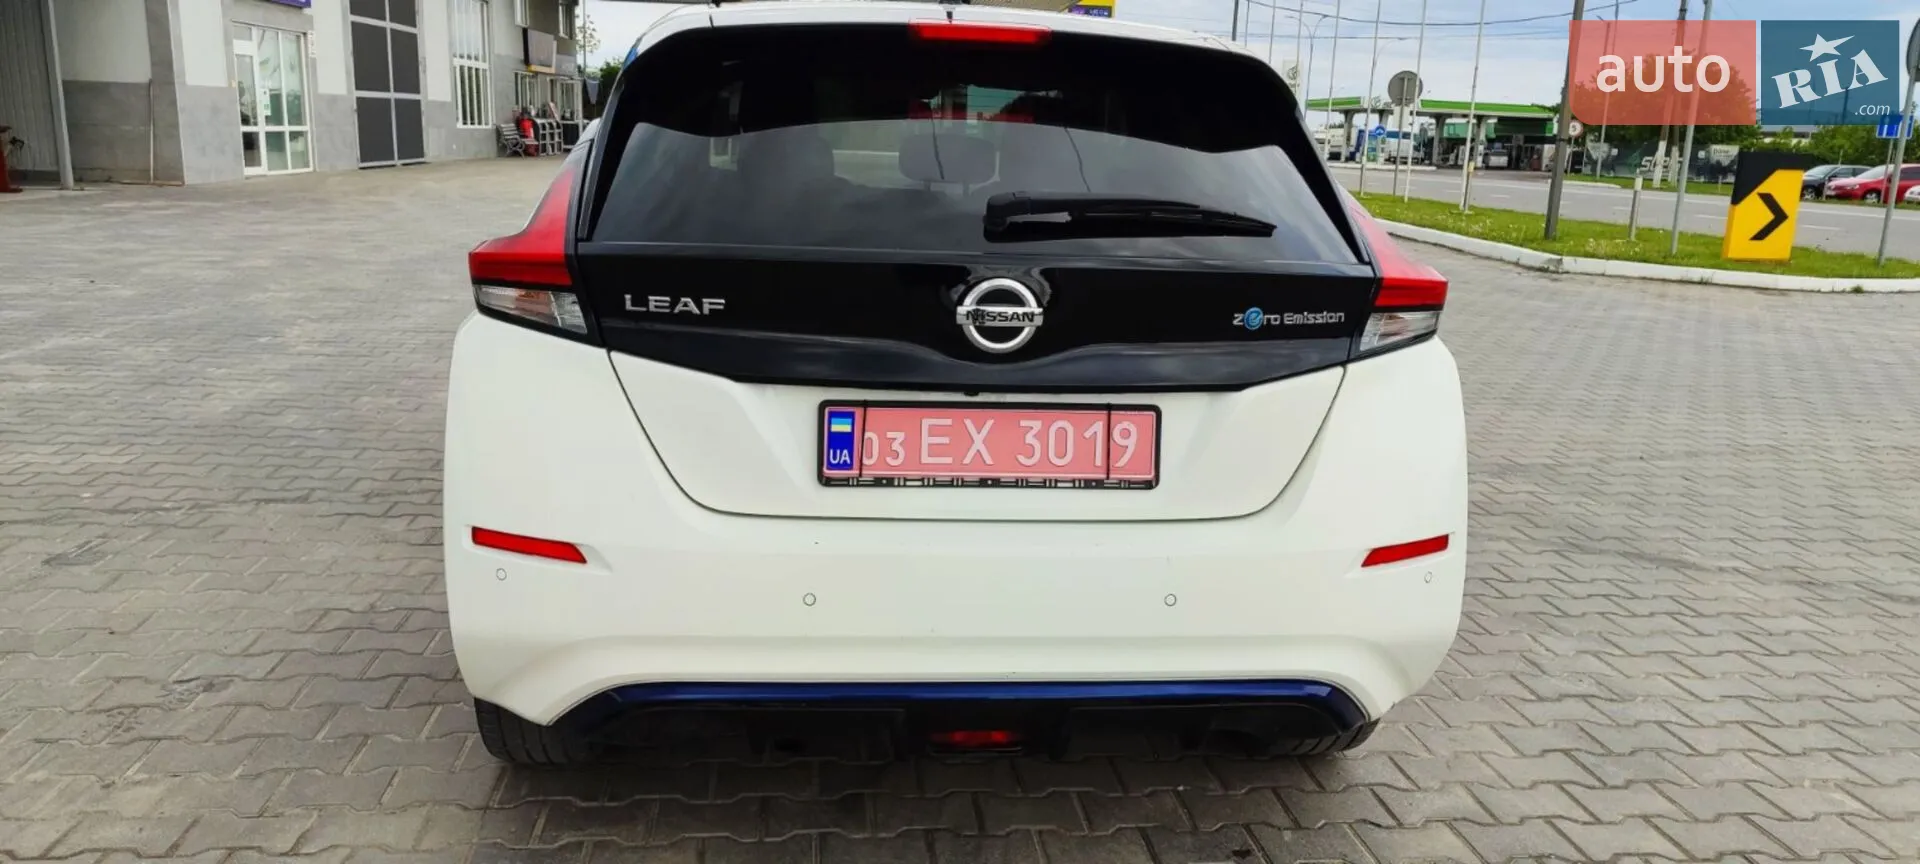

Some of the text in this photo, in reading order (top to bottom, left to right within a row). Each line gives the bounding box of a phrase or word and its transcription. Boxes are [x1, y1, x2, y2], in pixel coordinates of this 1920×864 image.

[623, 293, 726, 315] LEAF
[966, 310, 1035, 322] NISSAN
[1283, 311, 1345, 325] Emission
[861, 417, 1138, 467] 03 EX 3019
[829, 450, 851, 465] UA
